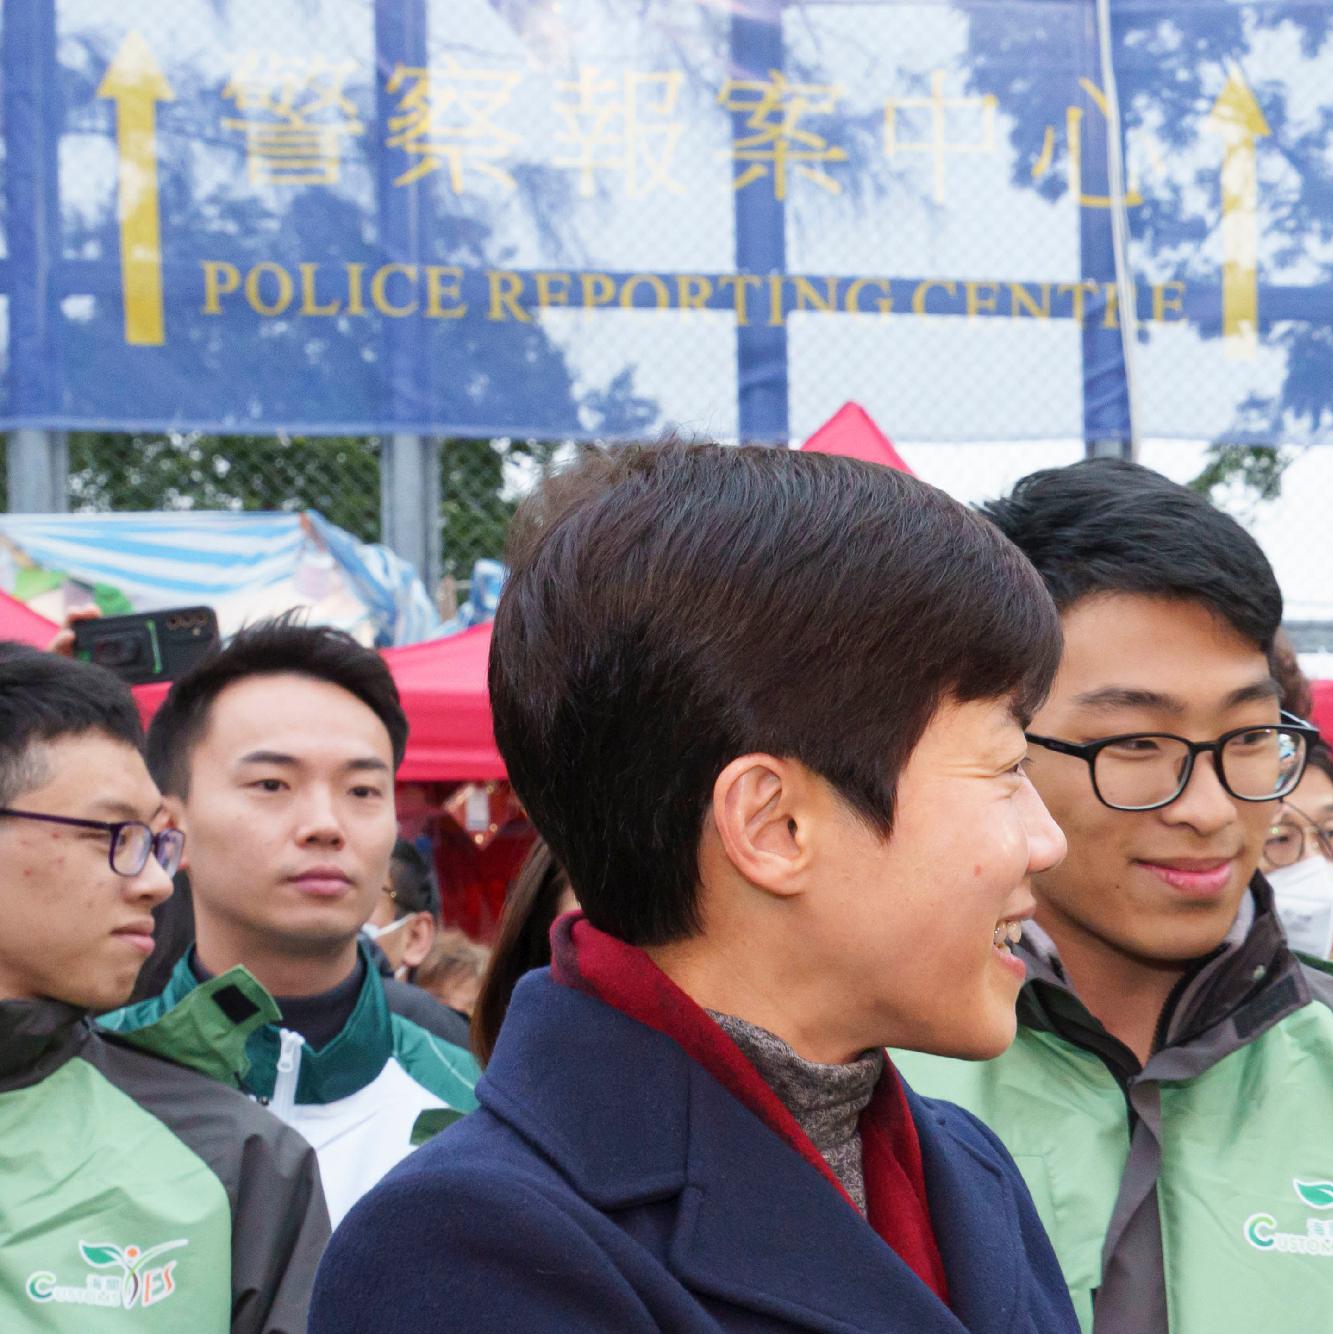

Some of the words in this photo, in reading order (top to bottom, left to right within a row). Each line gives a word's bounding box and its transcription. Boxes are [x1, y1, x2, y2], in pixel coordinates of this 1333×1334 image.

[220, 50, 1168, 204] 警察報案中心
[202, 261, 468, 319] POLICE
[486, 266, 895, 327] REPORTING
